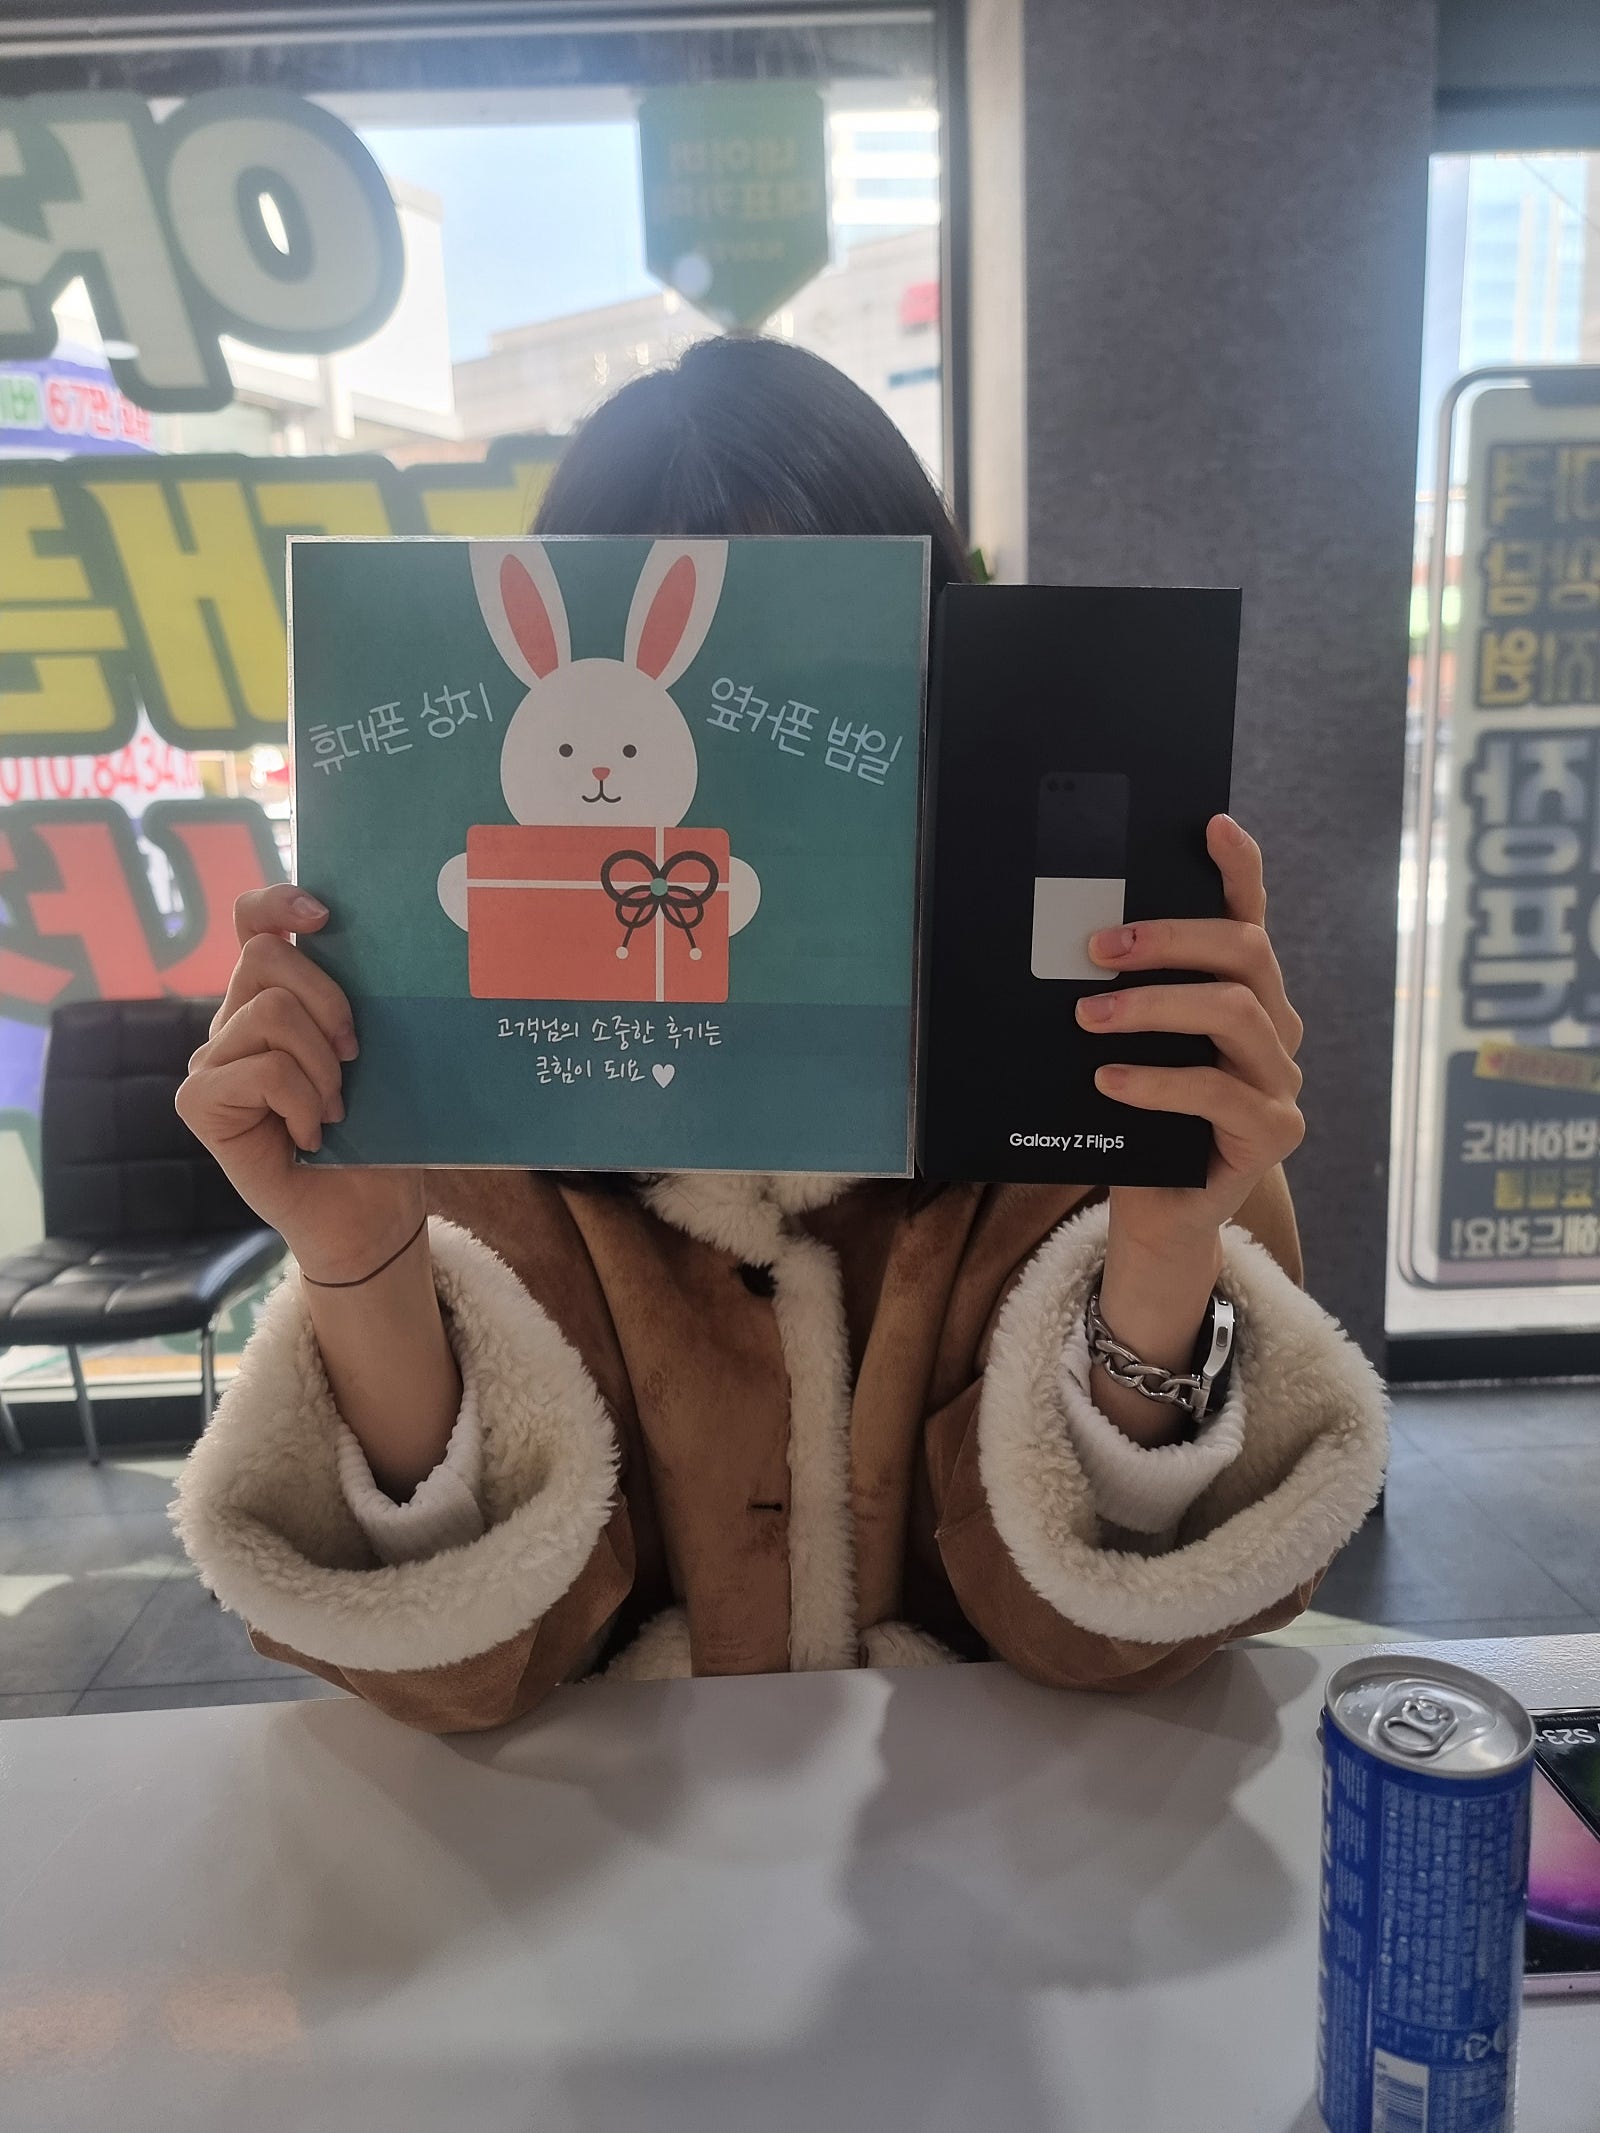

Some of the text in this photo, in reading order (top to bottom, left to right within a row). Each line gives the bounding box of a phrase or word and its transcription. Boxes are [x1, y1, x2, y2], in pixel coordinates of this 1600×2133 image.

[308, 682, 493, 775] 휴대폰 성지
[706, 677, 903, 786] 옆커폰 범일
[498, 1015, 722, 1050] 고객님의 소중한 후기는
[536, 1056, 645, 1084] 큰힘이 되요
[1009, 1132, 1125, 1153] Galaxy Z Flip5
